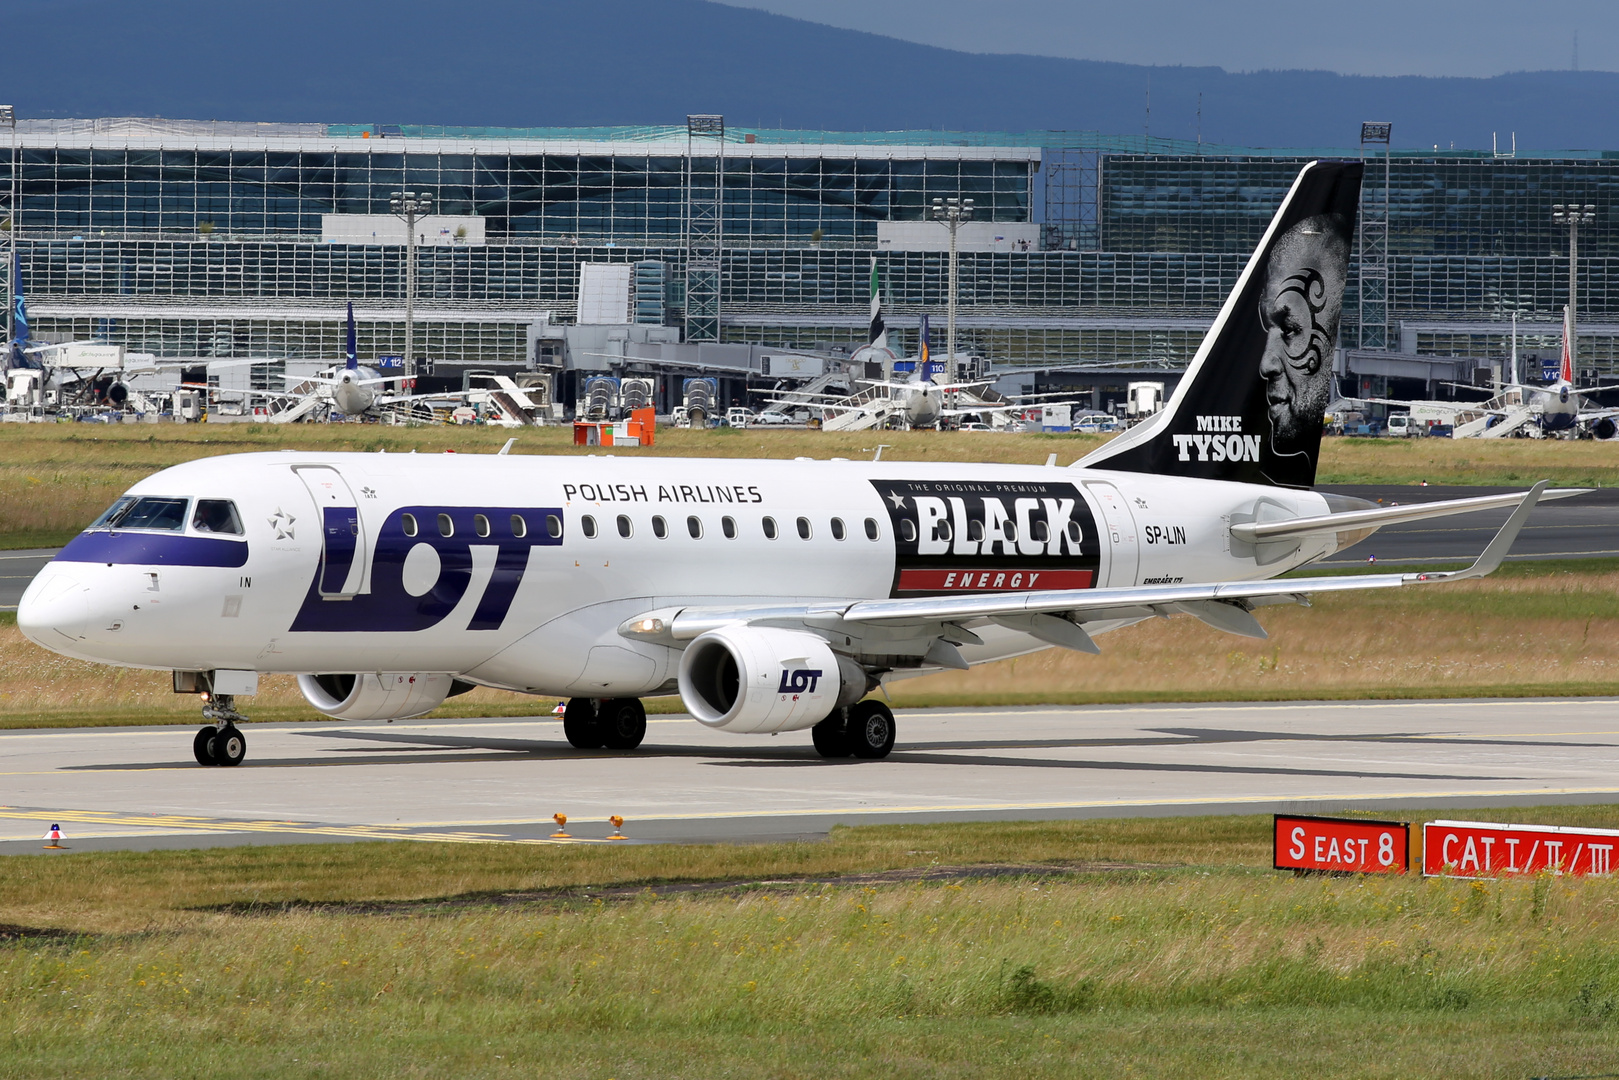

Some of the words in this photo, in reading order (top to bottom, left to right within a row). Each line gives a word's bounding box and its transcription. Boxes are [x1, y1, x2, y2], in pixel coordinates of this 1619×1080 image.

[380, 359, 387, 367] V
[390, 359, 402, 367] 112
[931, 364, 944, 372] 110
[1543, 371, 1550, 379] V
[1196, 415, 1242, 432] MIKE
[1172, 434, 1261, 462] TYSON
[562, 483, 649, 502] POLISH
[658, 485, 763, 503] AIRLINES
[908, 483, 930, 492] THE
[935, 483, 991, 493] ORIGINAL
[997, 484, 1048, 494] PREMIUM
[911, 496, 1084, 556] BLACK
[1144, 525, 1187, 545] SP-LIN
[288, 505, 564, 632] LOT
[239, 576, 252, 588] IN
[943, 572, 1040, 588] ENERGY
[777, 669, 823, 693] LOT
[1289, 826, 1306, 860] S
[1314, 835, 1369, 865] EAST
[1377, 832, 1395, 866] 8
[1442, 833, 1496, 871] CAT
